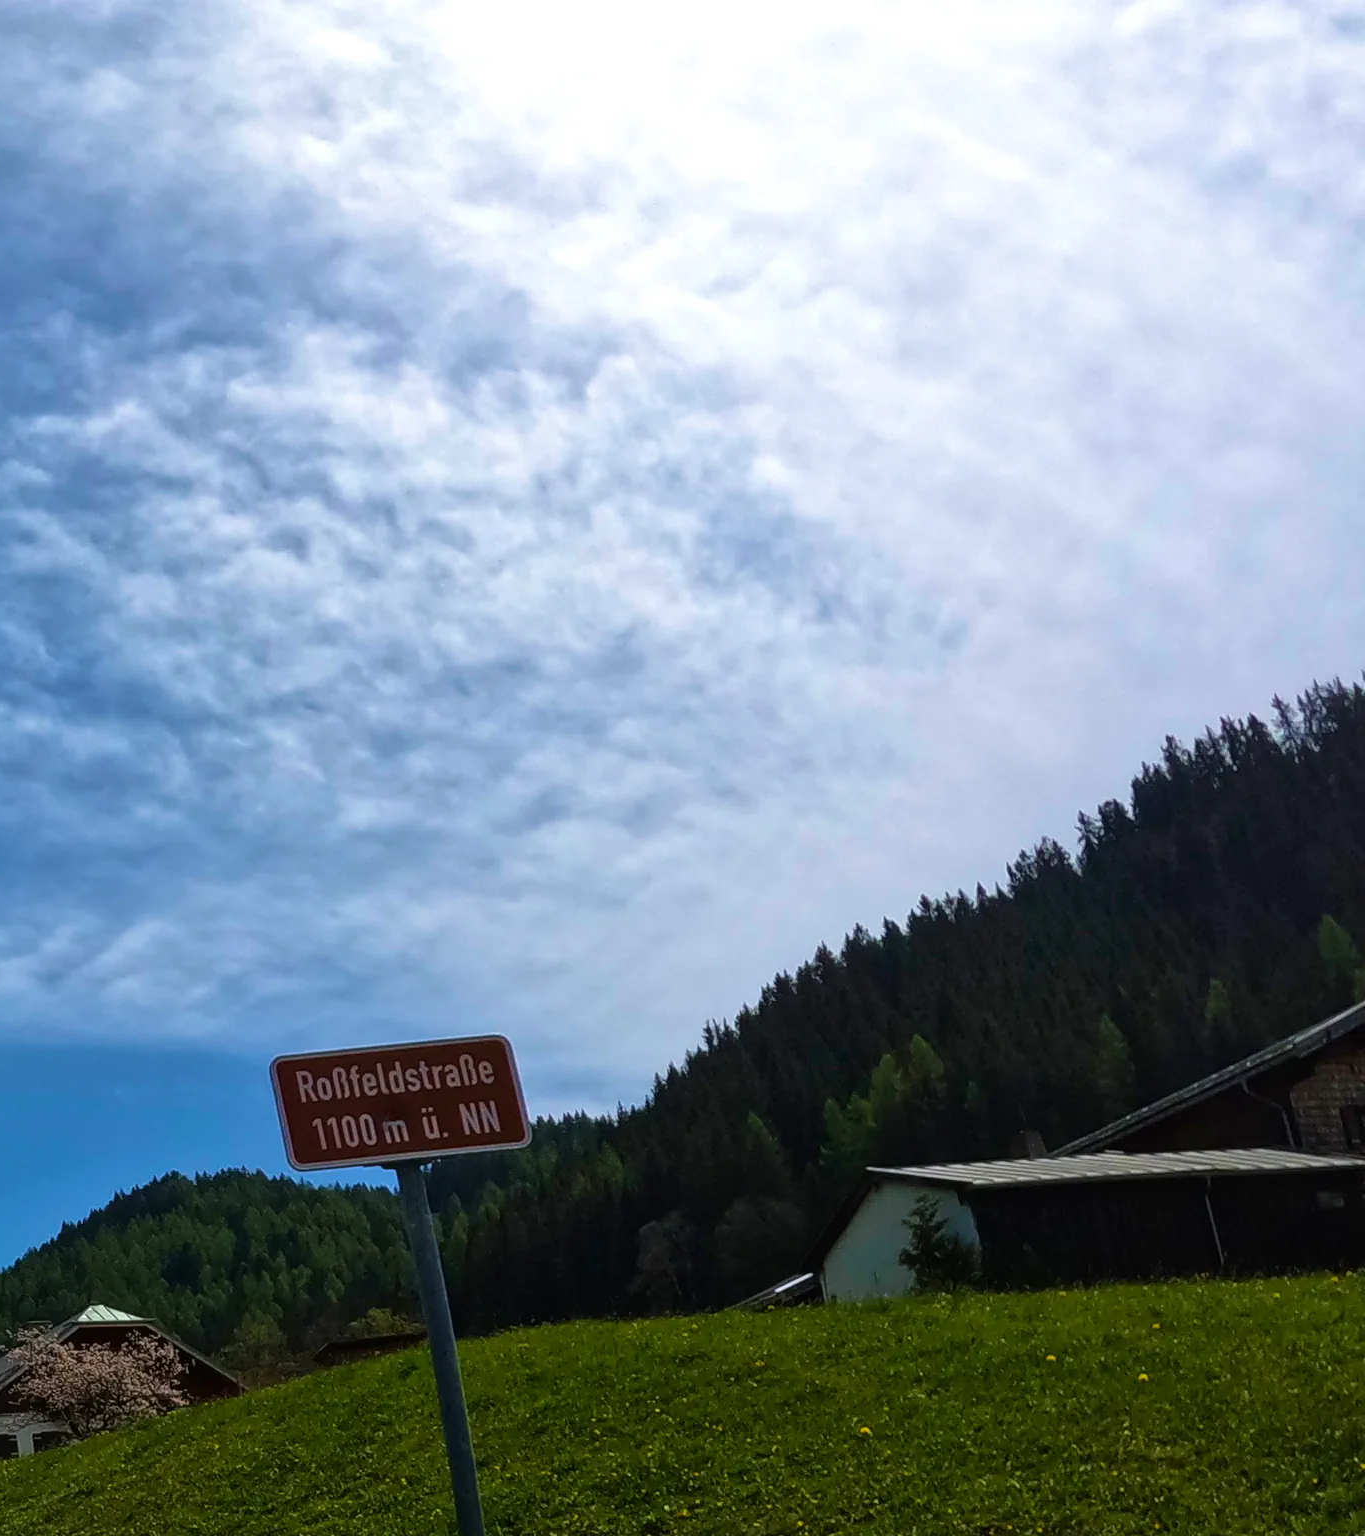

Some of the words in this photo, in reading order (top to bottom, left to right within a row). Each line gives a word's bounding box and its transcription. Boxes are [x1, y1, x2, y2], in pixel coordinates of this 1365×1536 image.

[296, 1054, 495, 1103] Roßfeldstraße
[312, 1114, 378, 1150] 1100
[382, 1119, 409, 1144] m
[421, 1107, 449, 1140] ü.
[459, 1100, 501, 1136] NN
